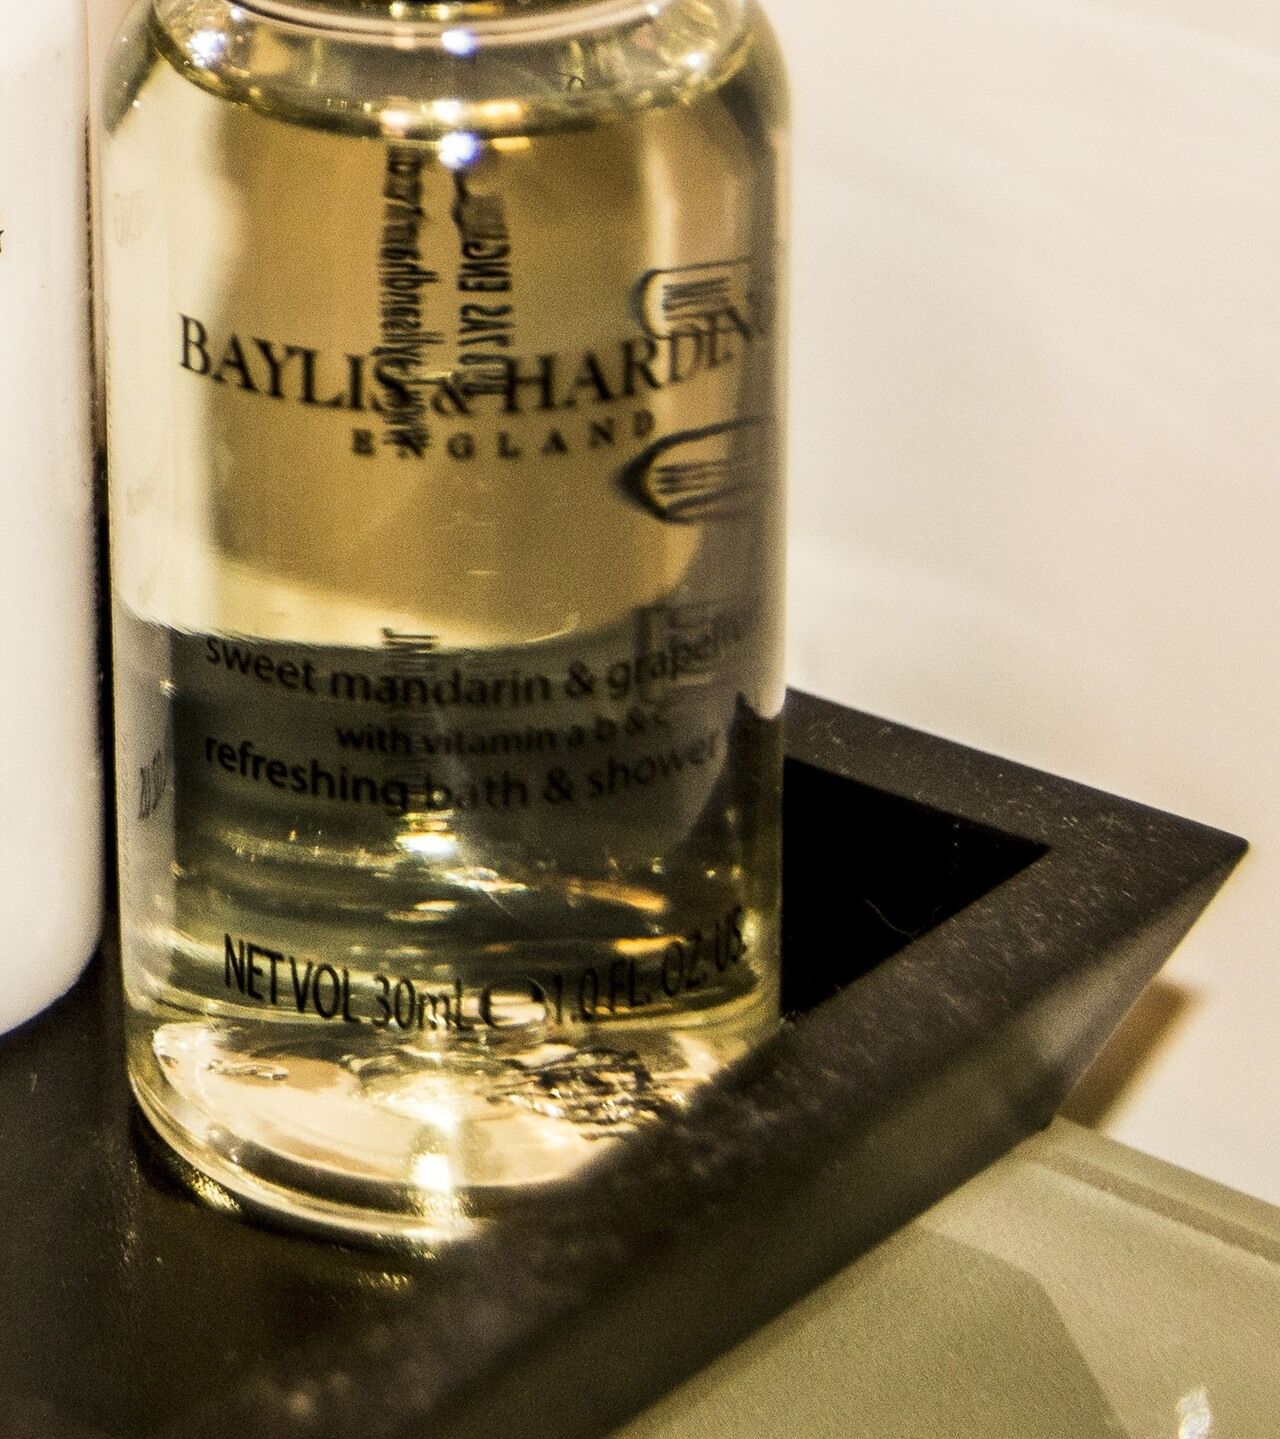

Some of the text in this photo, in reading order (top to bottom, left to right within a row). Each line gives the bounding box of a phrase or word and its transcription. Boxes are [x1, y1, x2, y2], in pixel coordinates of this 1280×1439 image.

[179, 311, 420, 416] BAYLIS
[205, 635, 317, 694] sweet
[329, 666, 552, 706] mandarin
[564, 661, 595, 700] &
[204, 733, 410, 816] refreshing
[542, 765, 576, 806] &
[337, 722, 412, 755] with
